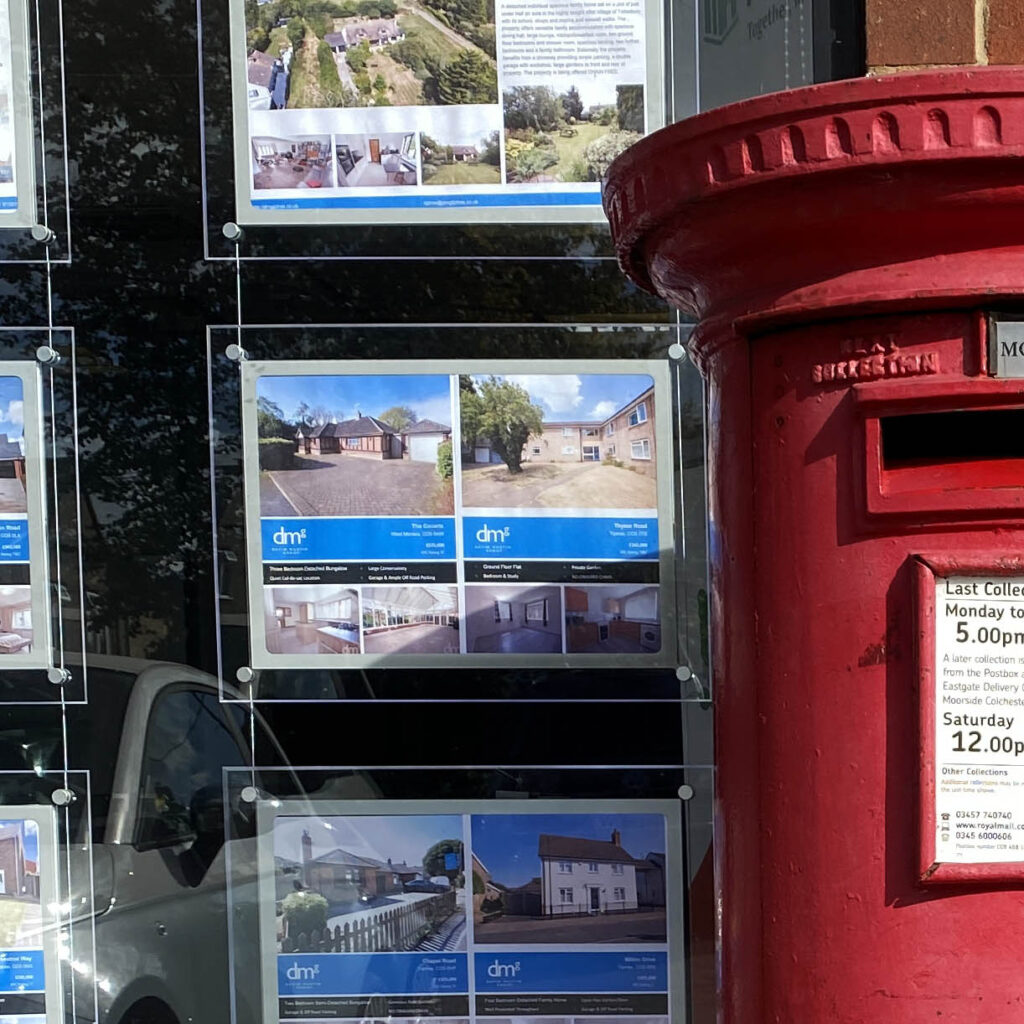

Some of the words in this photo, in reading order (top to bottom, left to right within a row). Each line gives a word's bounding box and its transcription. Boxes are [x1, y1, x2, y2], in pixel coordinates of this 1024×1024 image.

[945, 580, 978, 596] Last
[945, 603, 1004, 621] Monday
[1010, 605, 1024, 619] to
[943, 653, 950, 663] A
[952, 654, 972, 664] later
[975, 655, 1016, 665] collection
[1018, 655, 1024, 665] is
[943, 667, 964, 677] from
[967, 668, 981, 678] the
[984, 668, 1019, 678] Postbox
[943, 681, 981, 693] Eastgate
[983, 682, 1019, 694] Delivery
[942, 695, 983, 705] Moorside
[943, 712, 1015, 730] Saturday
[942, 767, 963, 776] Other
[966, 768, 1009, 777] Collections
[955, 811, 980, 819] 03457
[983, 811, 1012, 820] 740740
[955, 831, 976, 840] 0345
[978, 832, 1012, 841] 6000606
